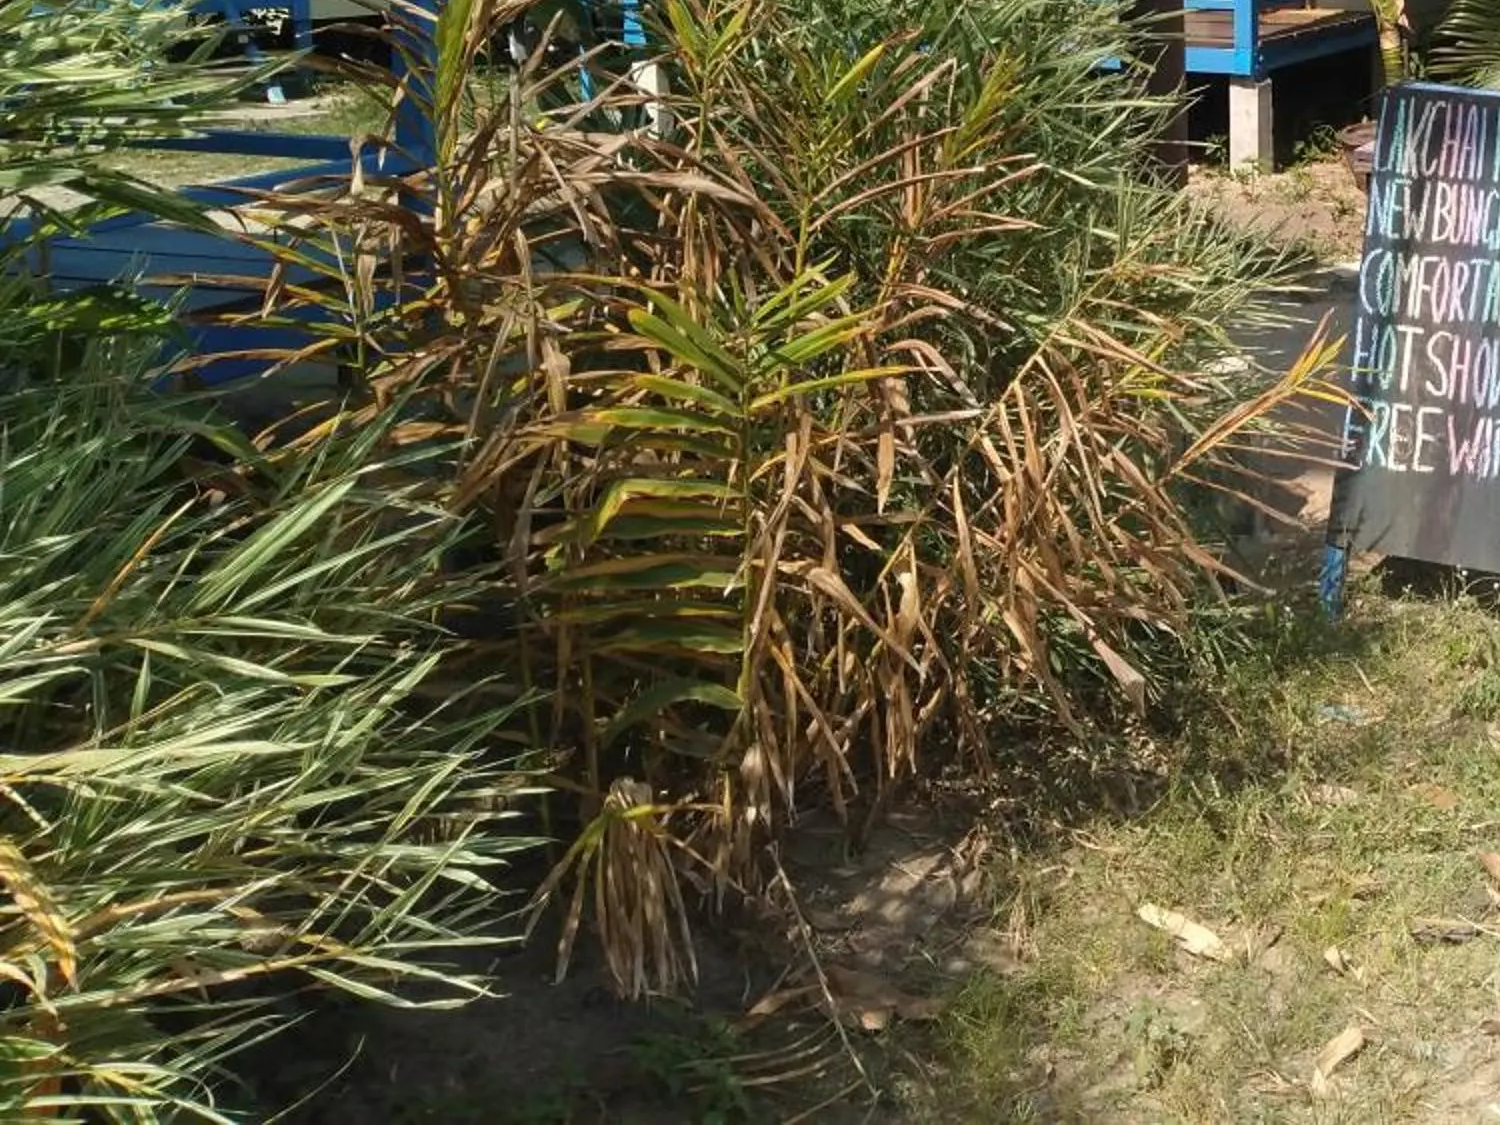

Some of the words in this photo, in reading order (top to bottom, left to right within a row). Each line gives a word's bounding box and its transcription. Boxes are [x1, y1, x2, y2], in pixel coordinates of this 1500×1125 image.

[1373, 96, 1487, 179] LAKCHAI
[1366, 177, 1429, 242] NEW
[1350, 317, 1425, 392] HOT
[1341, 400, 1443, 473] FREE
